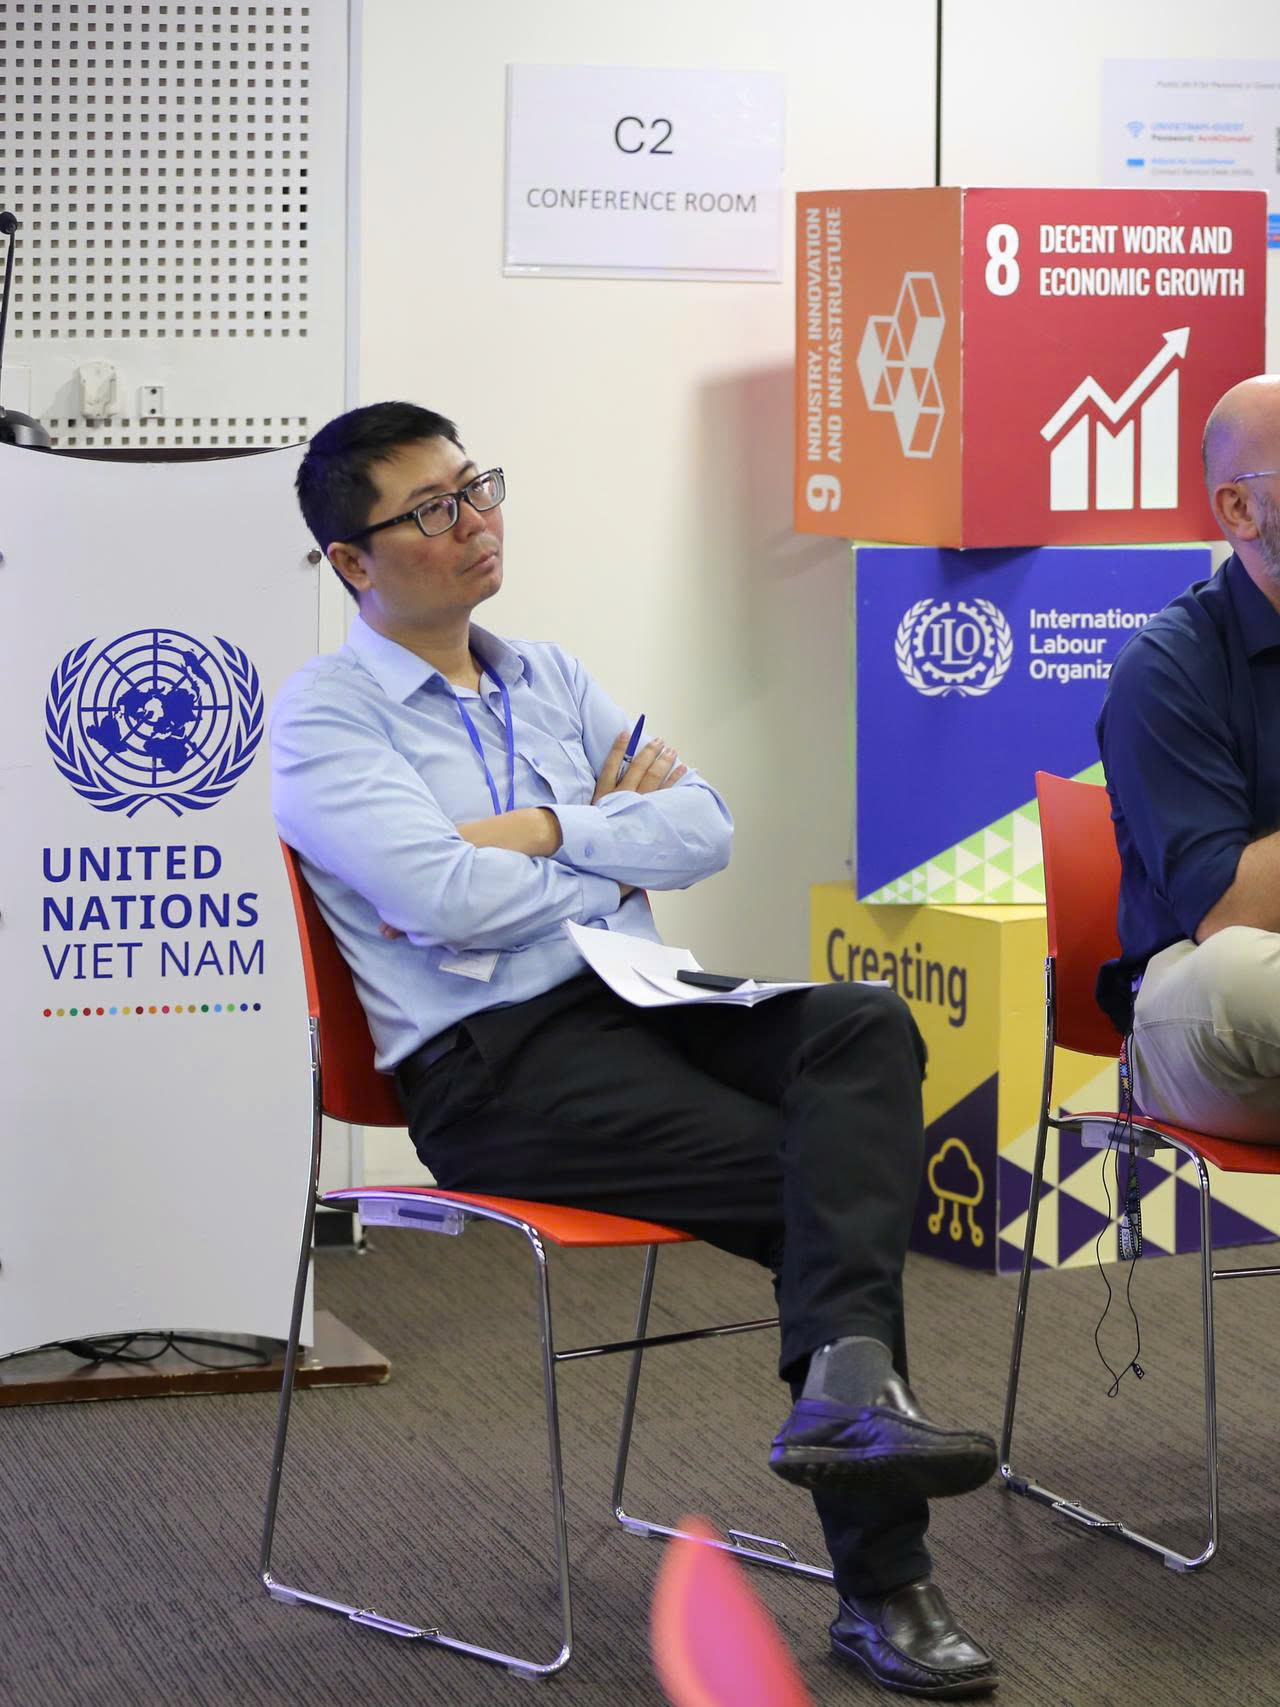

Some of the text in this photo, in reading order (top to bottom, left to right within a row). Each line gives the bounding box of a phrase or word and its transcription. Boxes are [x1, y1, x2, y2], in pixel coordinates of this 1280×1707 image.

[615, 116, 674, 154] C2
[526, 188, 757, 213] CONFERENCE ROOM
[984, 223, 1020, 296] 8
[1039, 225, 1233, 255] DECENT WORK AND
[806, 207, 822, 340] INNOVATION
[1039, 267, 1245, 297] ECONOMIC GROWTH
[826, 206, 842, 464] AND INFRASTRUCTURE
[806, 473, 841, 513] 9
[1029, 608, 1159, 630] Internation
[929, 617, 982, 665] ILO
[1029, 634, 1108, 655] Labour
[1029, 659, 1113, 685] Organiz
[42, 844, 223, 883] UNITED
[42, 891, 259, 932] NATIONS
[42, 938, 265, 981] VIET NAM
[826, 927, 968, 1028] Creating
